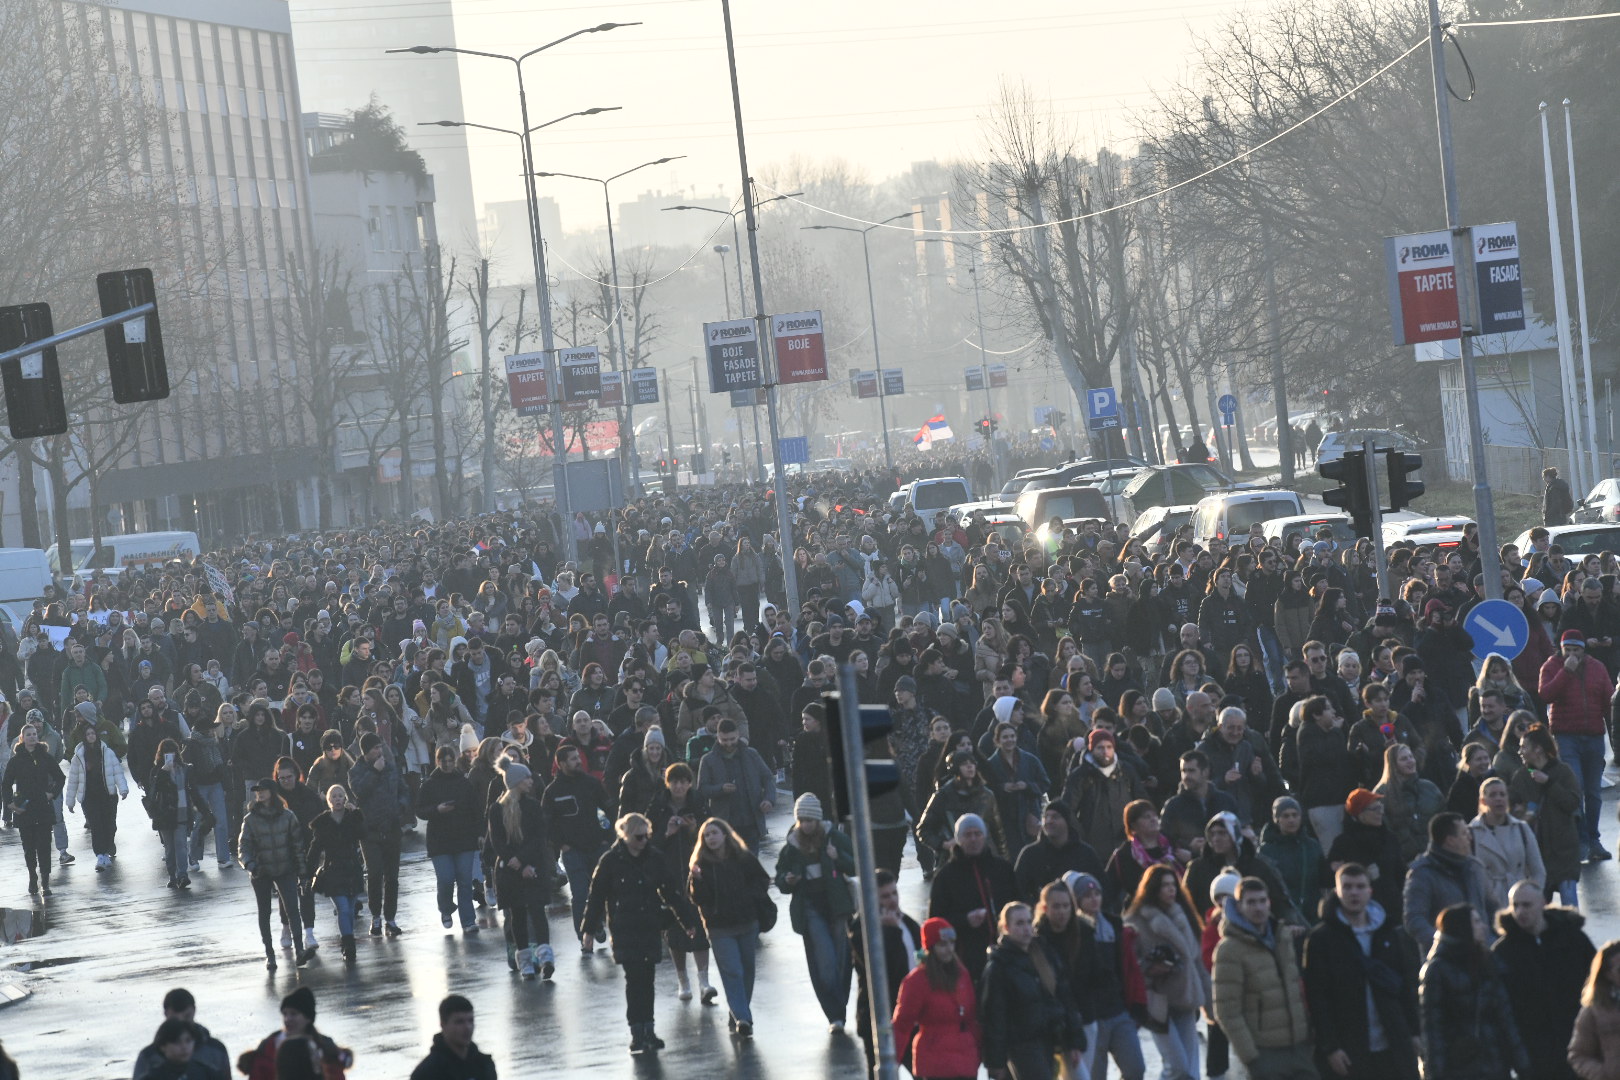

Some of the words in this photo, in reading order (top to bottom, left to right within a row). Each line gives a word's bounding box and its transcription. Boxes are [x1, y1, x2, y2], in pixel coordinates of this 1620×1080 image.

[1487, 234, 1517, 249] ROMA
[1411, 243, 1450, 258] ROMA
[1490, 264, 1520, 283] FASADE
[1414, 272, 1454, 293] TAPETE
[786, 318, 819, 329] ROMA
[1420, 320, 1458, 333] WWW.ROMA.RS
[719, 326, 752, 337] ROMA
[788, 338, 810, 350] BOJE
[570, 351, 596, 360] ROMA
[722, 346, 744, 358] BOJE
[515, 357, 542, 367] ROMA
[723, 357, 756, 371] FASADE
[517, 371, 545, 383] TAPETE
[572, 366, 598, 376] FASADE
[725, 370, 757, 384] TAPETE
[1093, 391, 1110, 415] P
